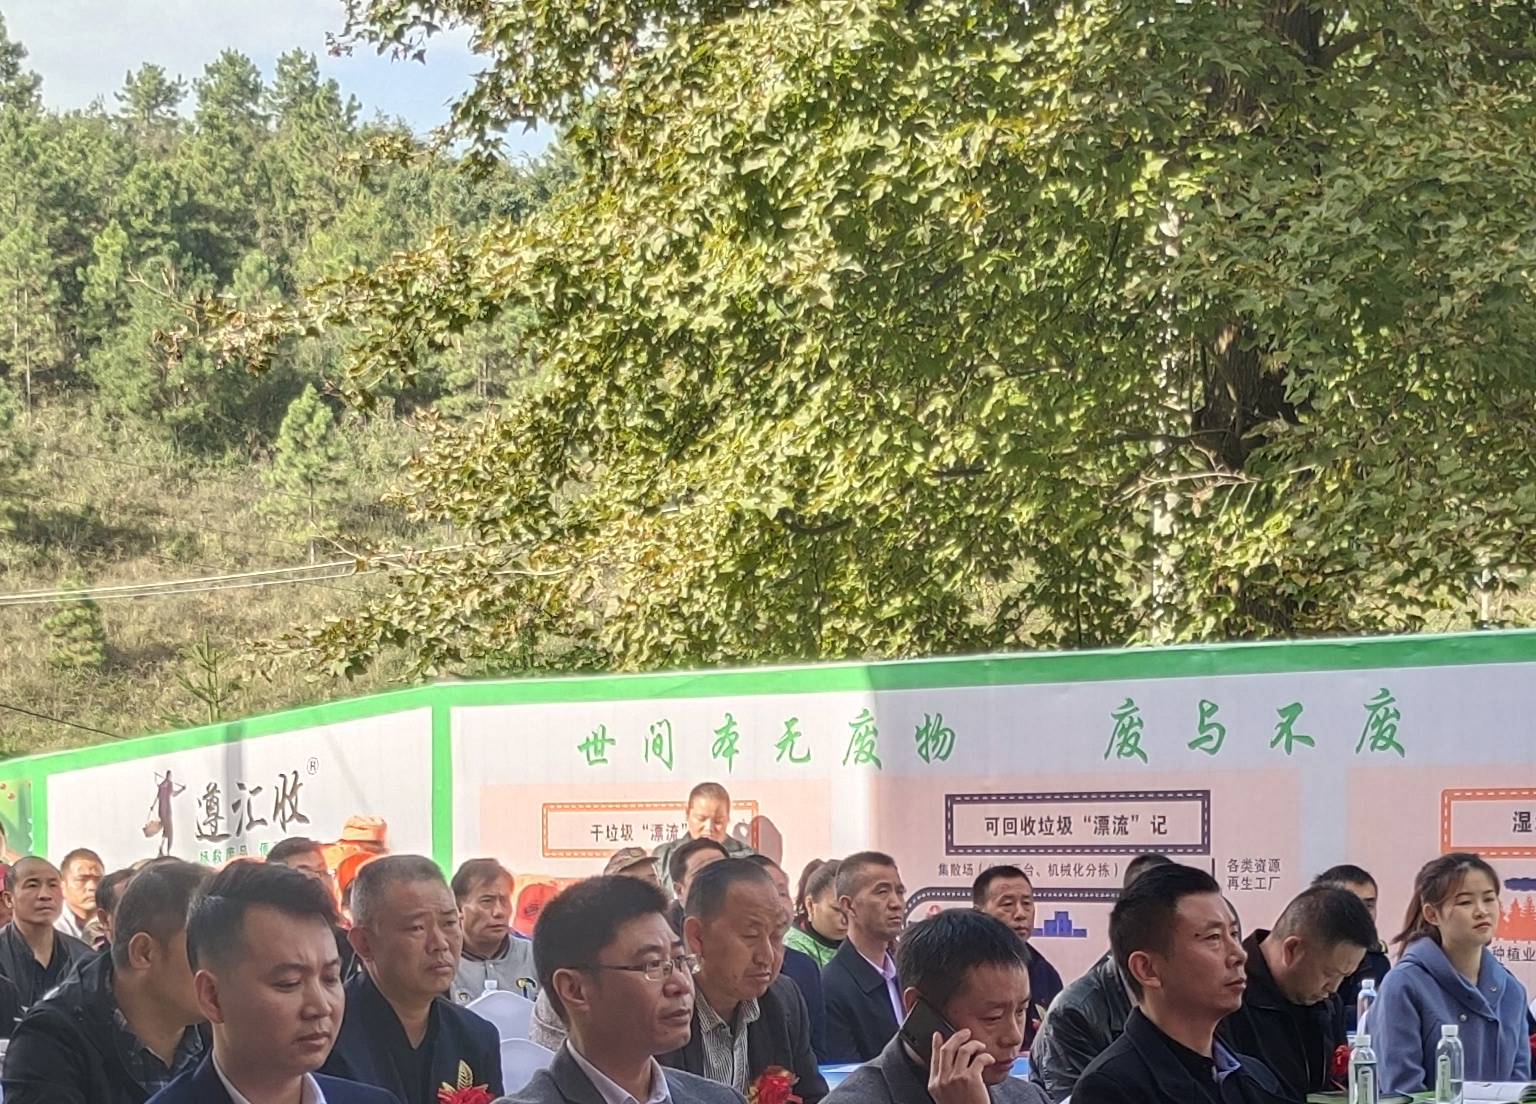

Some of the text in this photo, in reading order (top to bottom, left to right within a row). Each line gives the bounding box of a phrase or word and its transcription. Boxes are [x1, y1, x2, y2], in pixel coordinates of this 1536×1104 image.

[576, 707, 958, 772] 世间本无废物
[1104, 687, 1407, 763] 废与不废
[983, 814, 1168, 837] 可回收垃圾“漂流”记
[1226, 858, 1282, 875] 各类资源
[1226, 876, 1282, 892] 再生工厂
